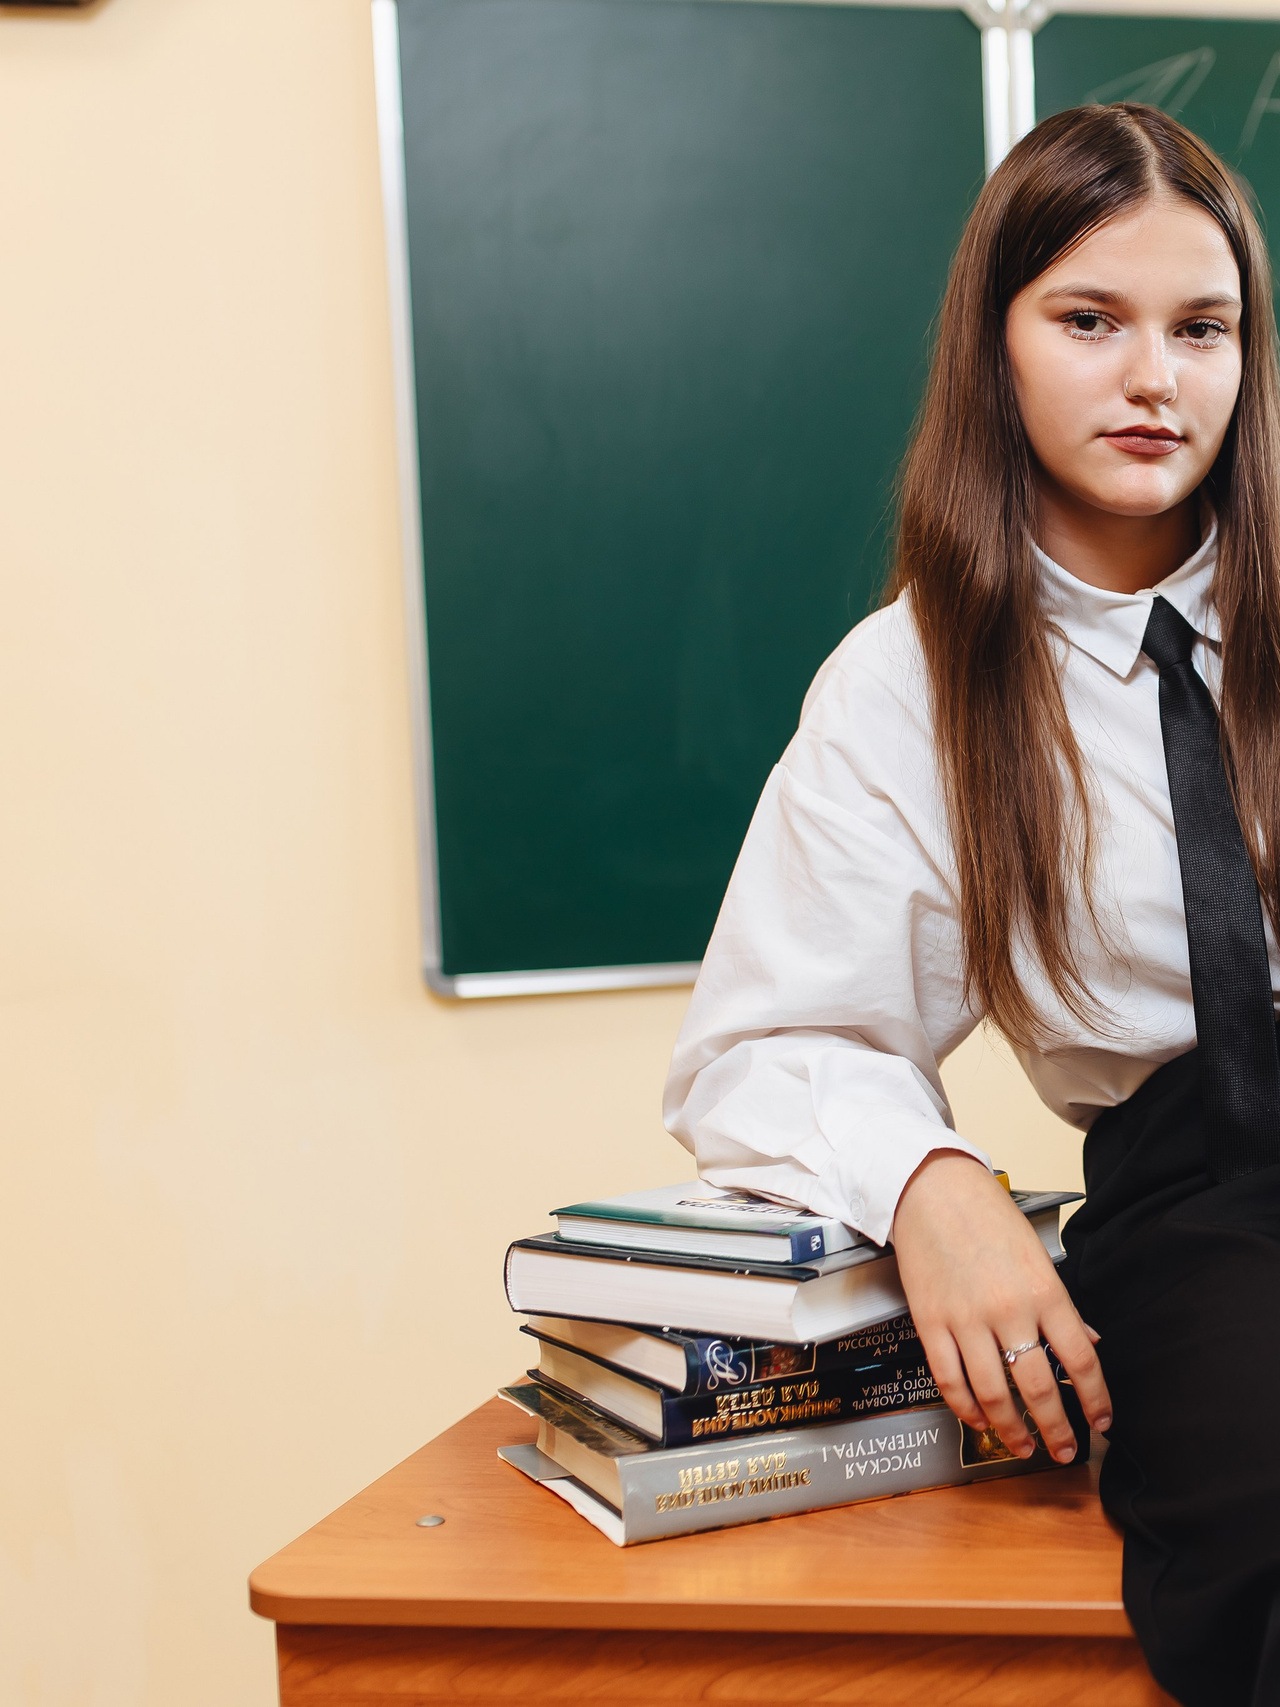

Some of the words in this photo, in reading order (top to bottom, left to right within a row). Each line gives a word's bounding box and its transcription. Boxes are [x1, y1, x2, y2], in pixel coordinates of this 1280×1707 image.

[838, 1332, 895, 1352] РУССКОГО
[715, 1385, 776, 1422] ДЕТЕЙ
[781, 1379, 820, 1403] ДЛЯ
[852, 1393, 905, 1411] СЛОВАРЬ
[862, 1381, 900, 1397] ЯЗЫКА
[692, 1397, 842, 1438] ЭНЦИКЛОПЕДИЯ
[832, 1428, 940, 1460] ЛИТЕРАТУРА
[678, 1458, 741, 1492] ДЕТЕЙ
[746, 1450, 788, 1476] ДЛЯ
[845, 1451, 922, 1480] РУССКАЯ
[655, 1468, 812, 1514] ЭНЦИКЛОПЕДИЯ
